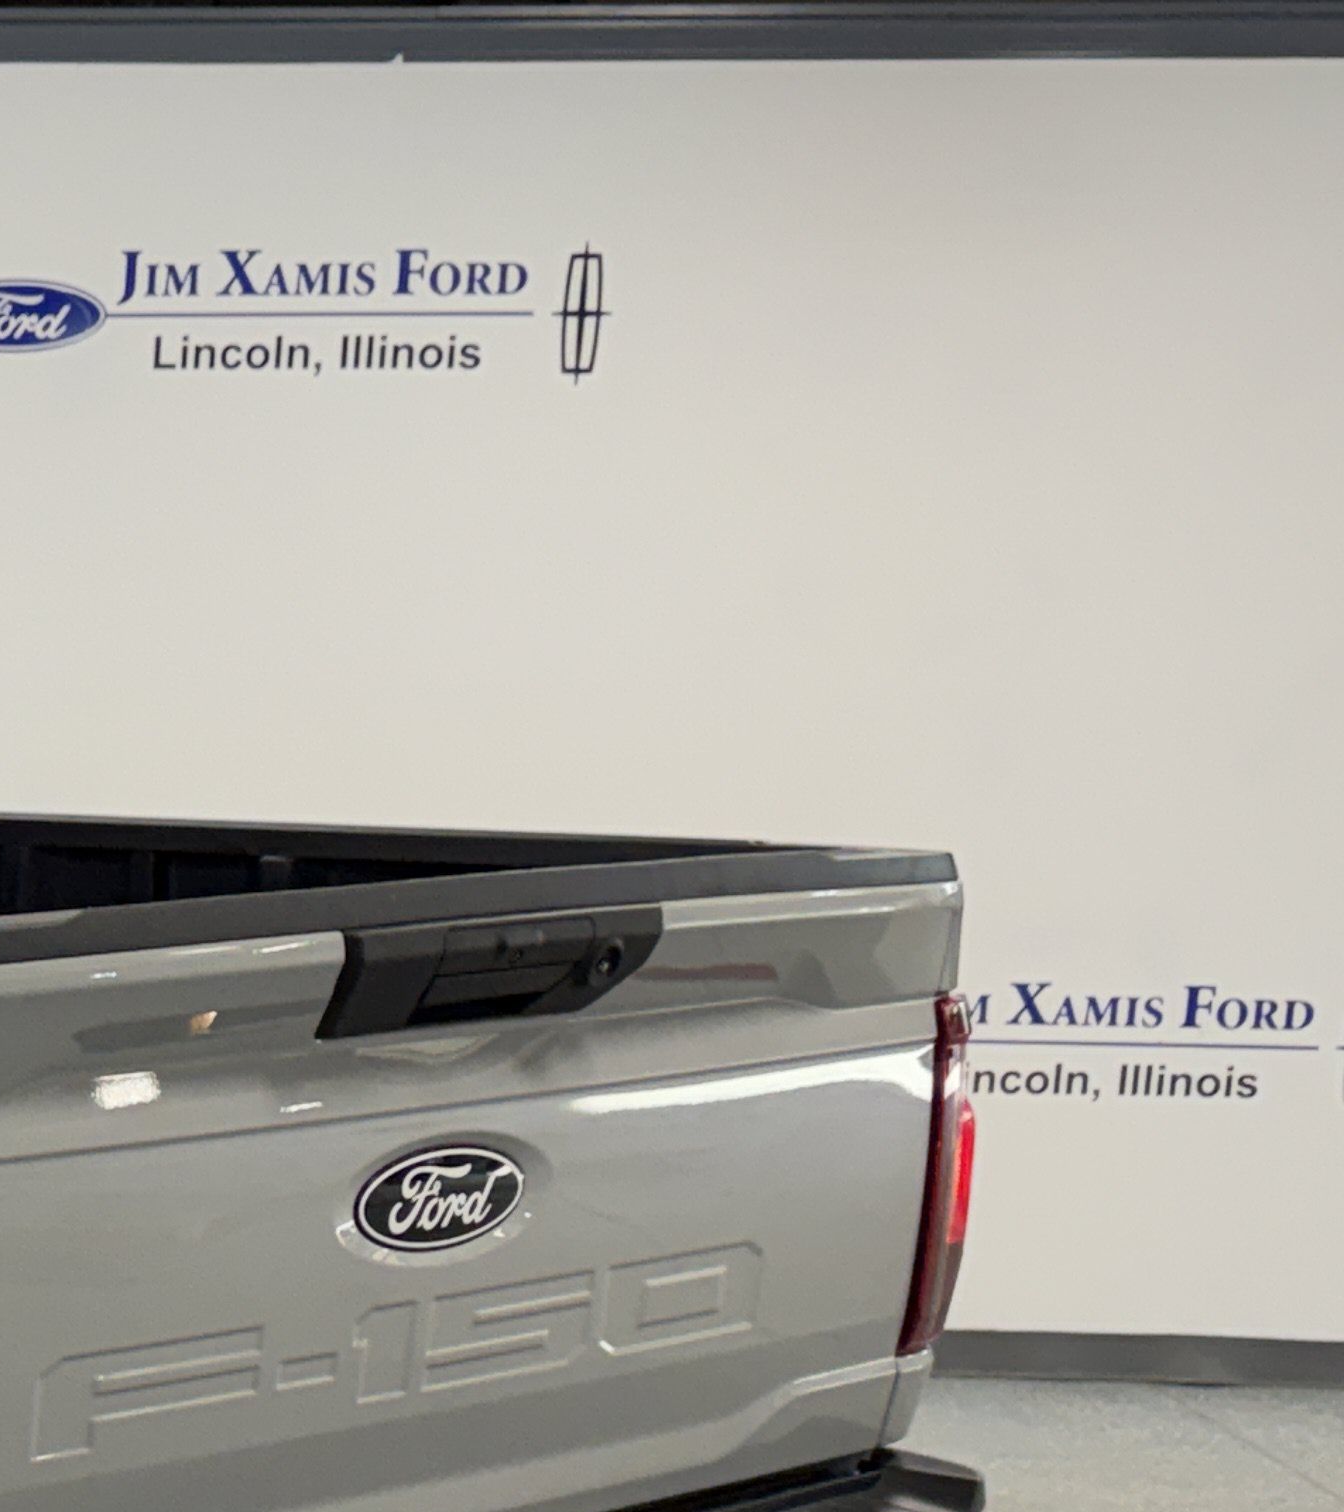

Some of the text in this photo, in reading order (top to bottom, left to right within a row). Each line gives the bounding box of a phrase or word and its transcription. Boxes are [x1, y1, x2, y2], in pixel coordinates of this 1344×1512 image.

[118, 248, 529, 305] JIM XAMIS FORD
[152, 334, 481, 376] Lincoln, Illinois
[1005, 982, 1165, 1028] XAMIS
[1179, 986, 1315, 1031] FORD
[964, 1063, 1259, 1102] incoln, Illinois
[388, 1163, 515, 1237] Ford
[30, 1240, 764, 1463] F-150
